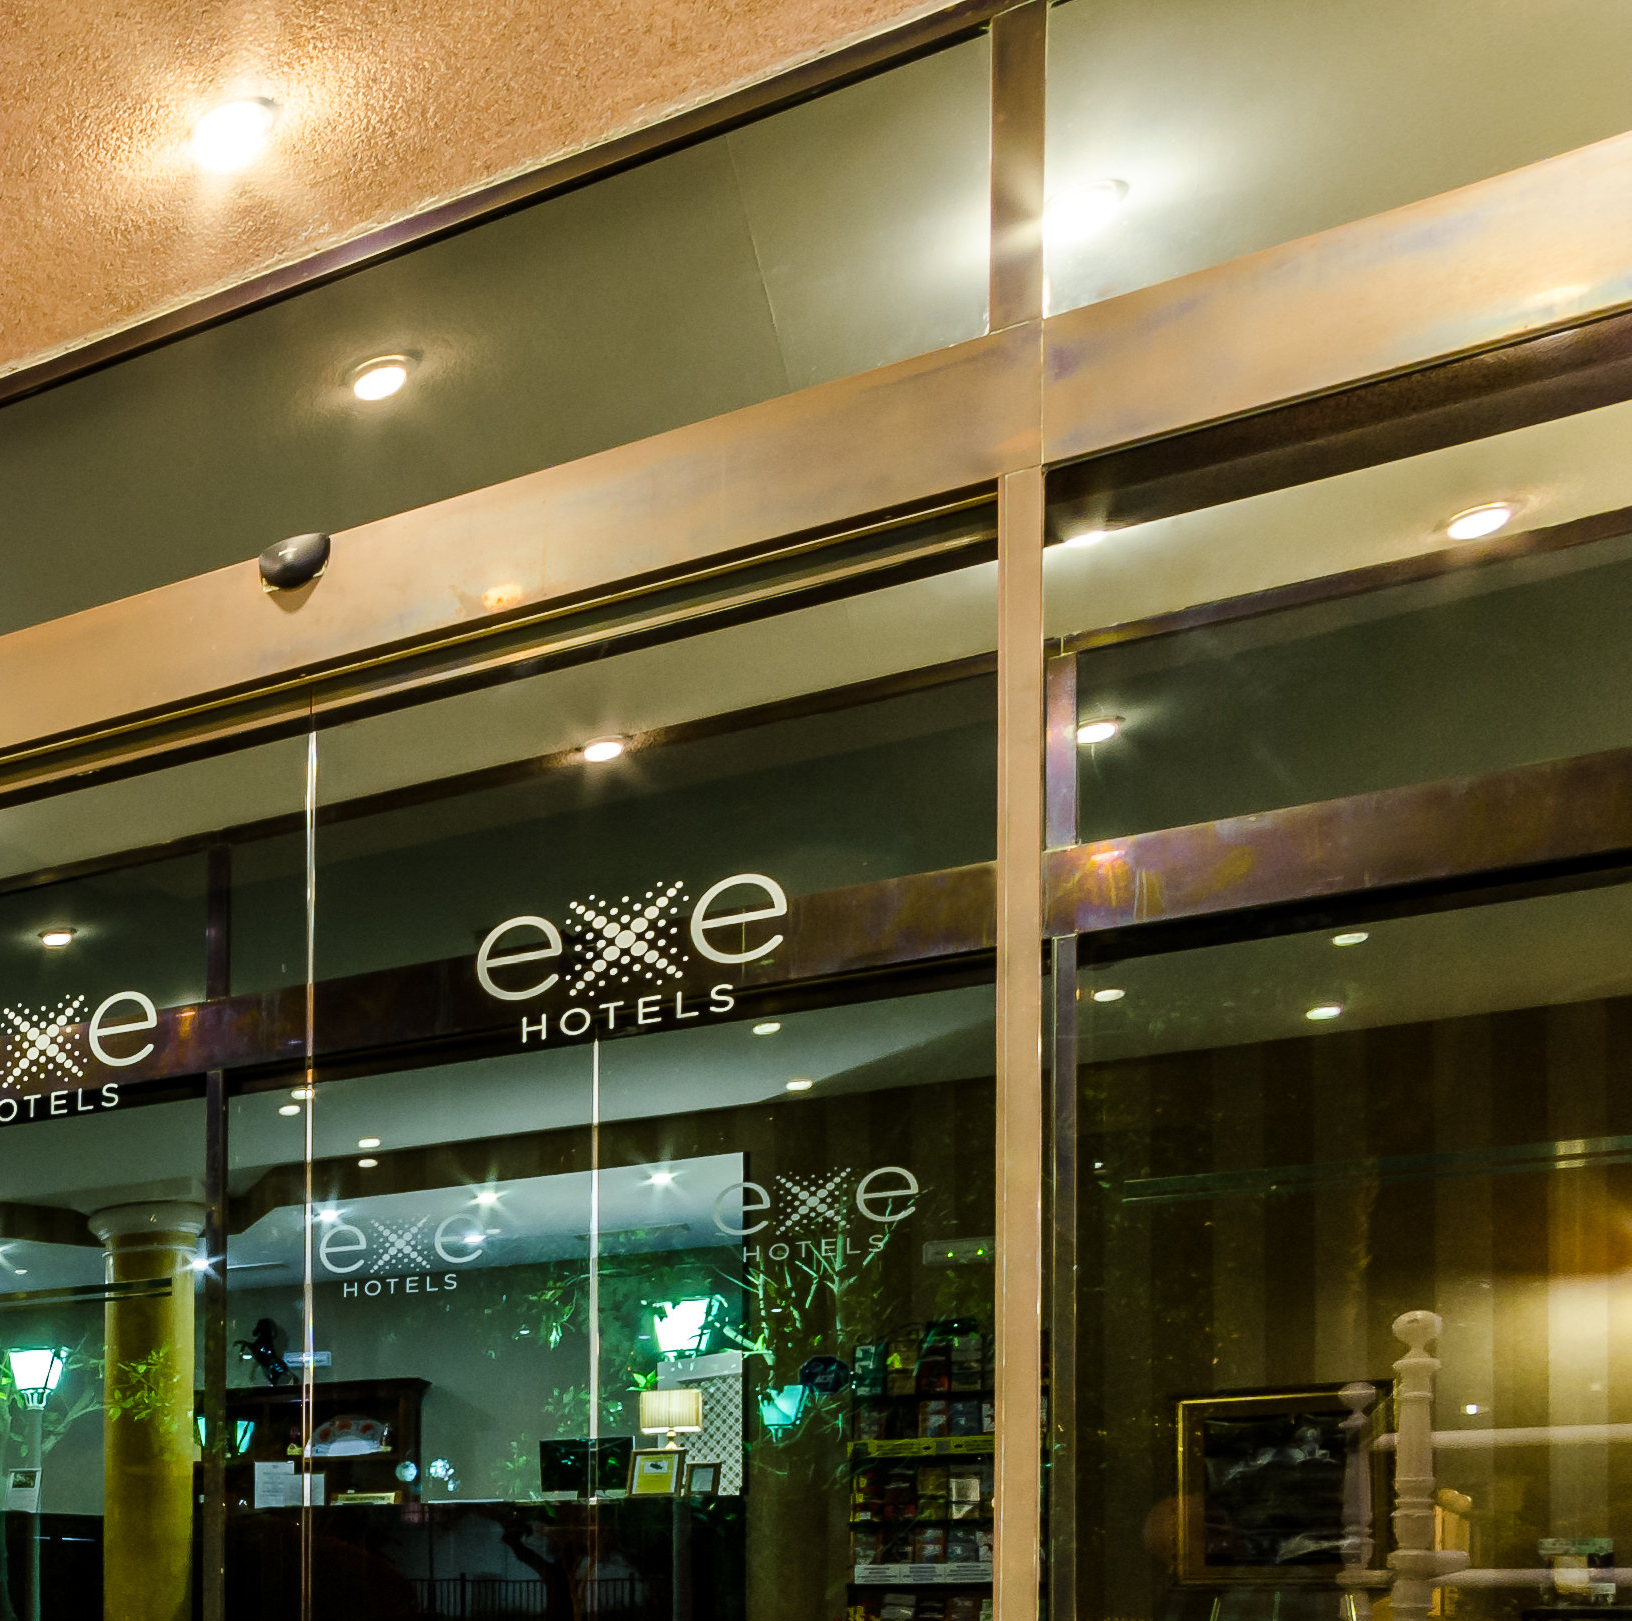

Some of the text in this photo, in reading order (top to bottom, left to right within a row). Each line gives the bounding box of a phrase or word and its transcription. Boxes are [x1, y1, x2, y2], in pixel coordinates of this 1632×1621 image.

[477, 873, 788, 1001] exe
[521, 983, 736, 1043] HOTELS
[713, 1166, 919, 1236] exe
[319, 1213, 485, 1275] exe
[742, 1233, 885, 1264] HOTELS
[343, 1273, 458, 1298] HOTELS
